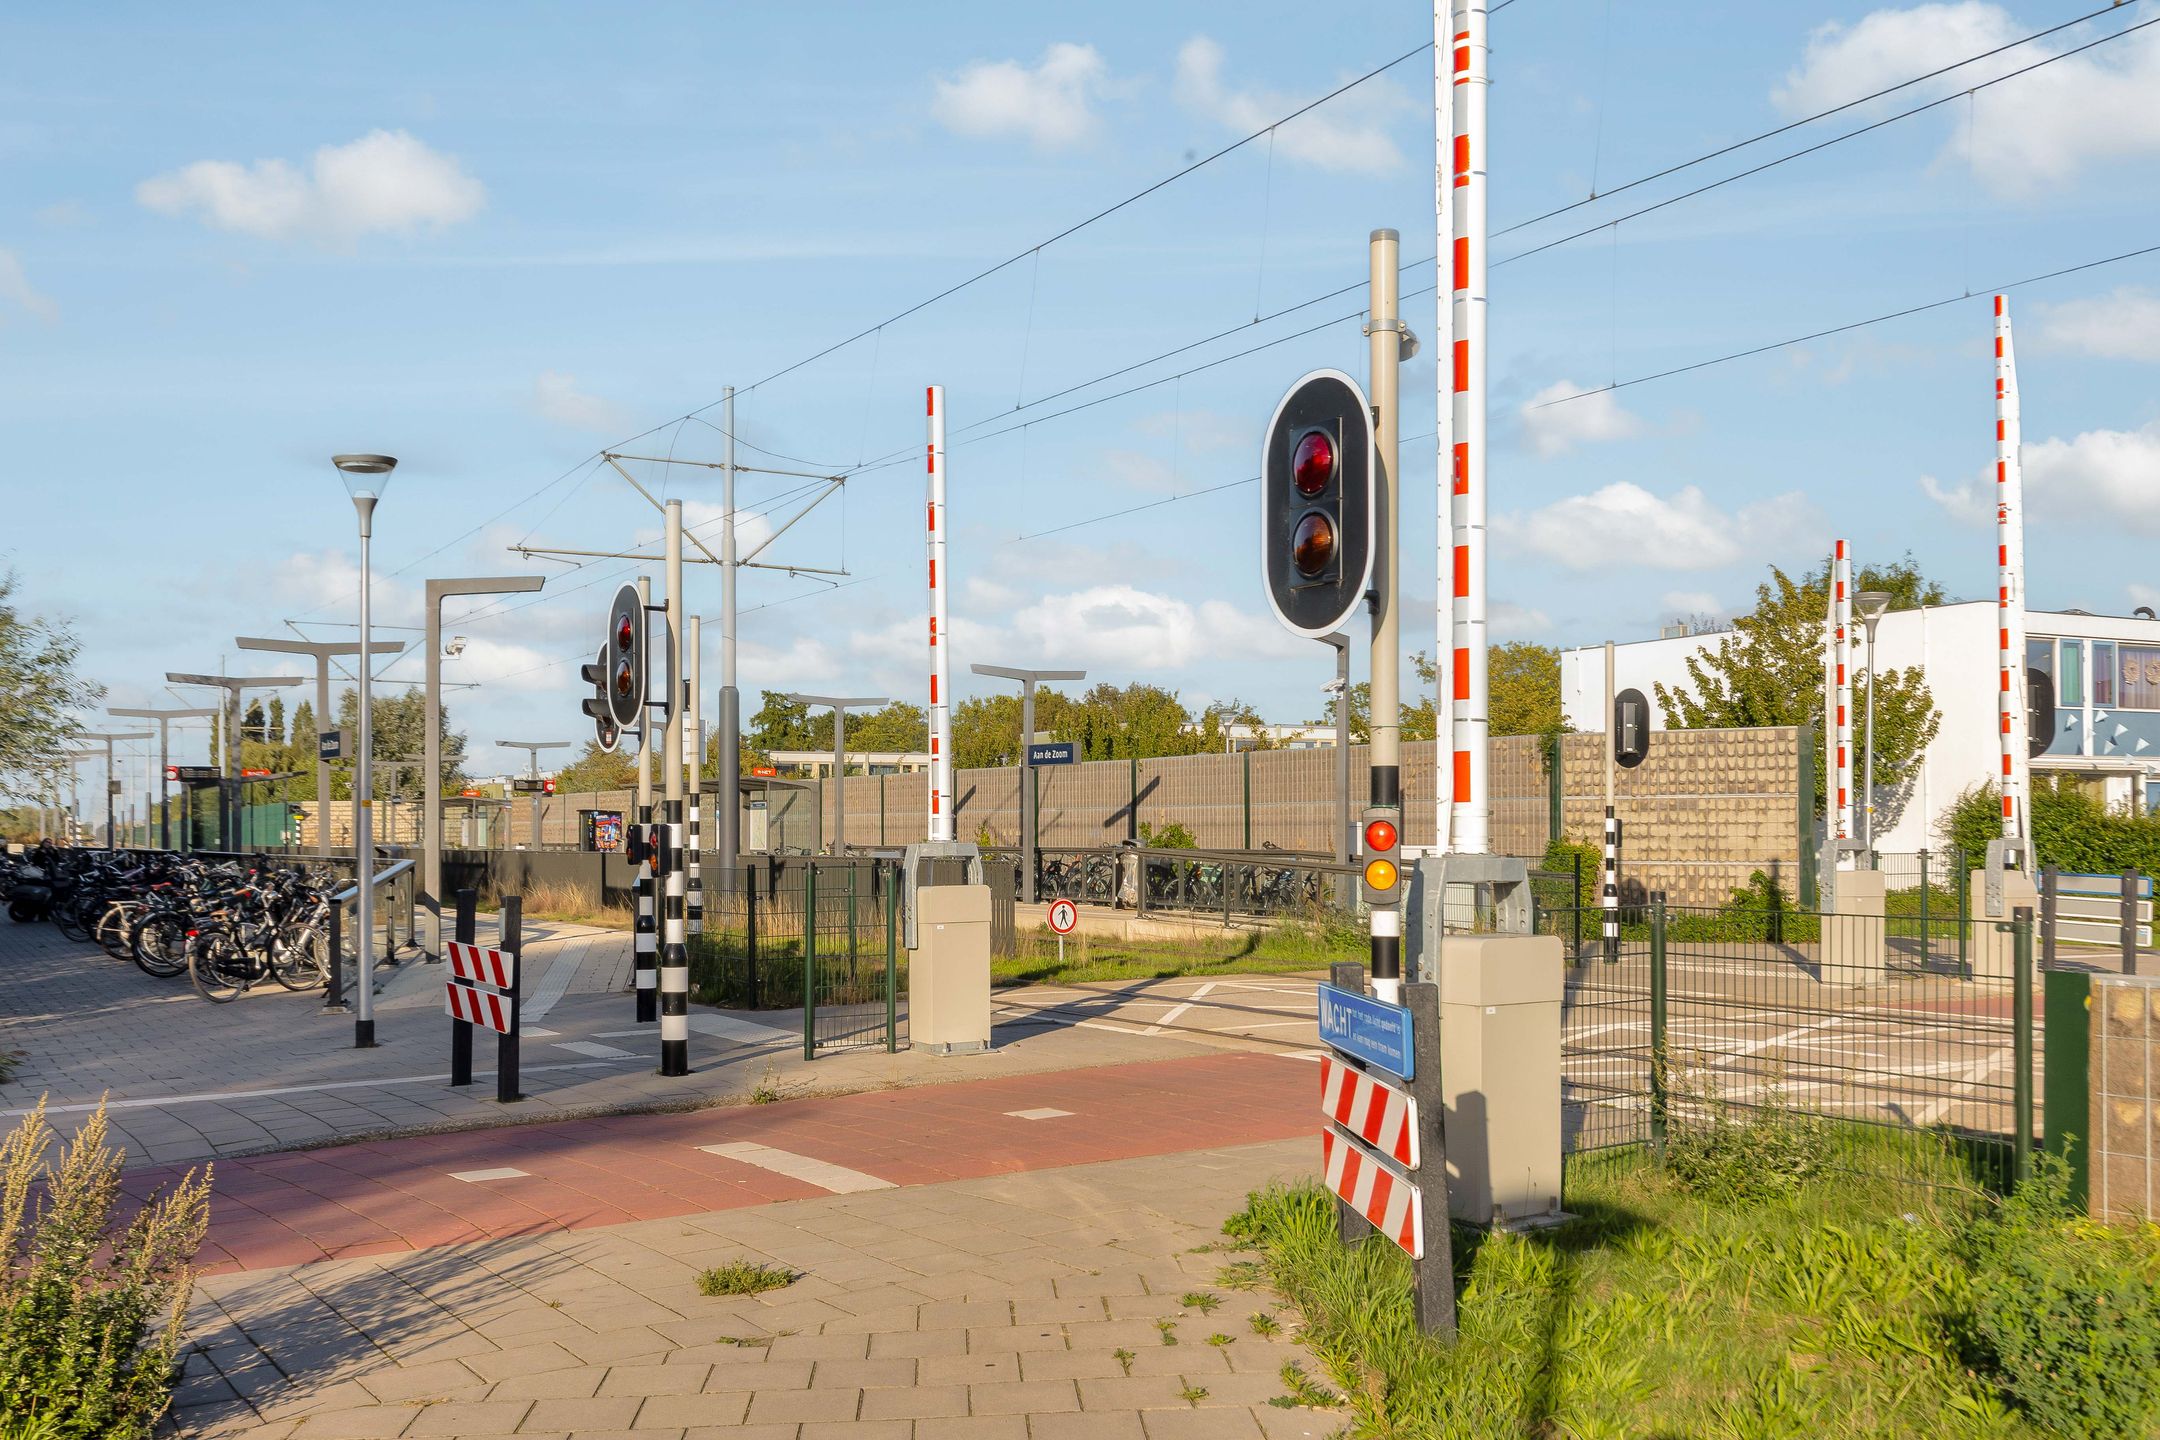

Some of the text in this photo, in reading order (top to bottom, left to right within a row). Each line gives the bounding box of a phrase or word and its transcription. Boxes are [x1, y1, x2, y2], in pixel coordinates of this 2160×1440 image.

[1033, 750, 1068, 759] Aan de Zoom
[1320, 997, 1352, 1039] WACHT
